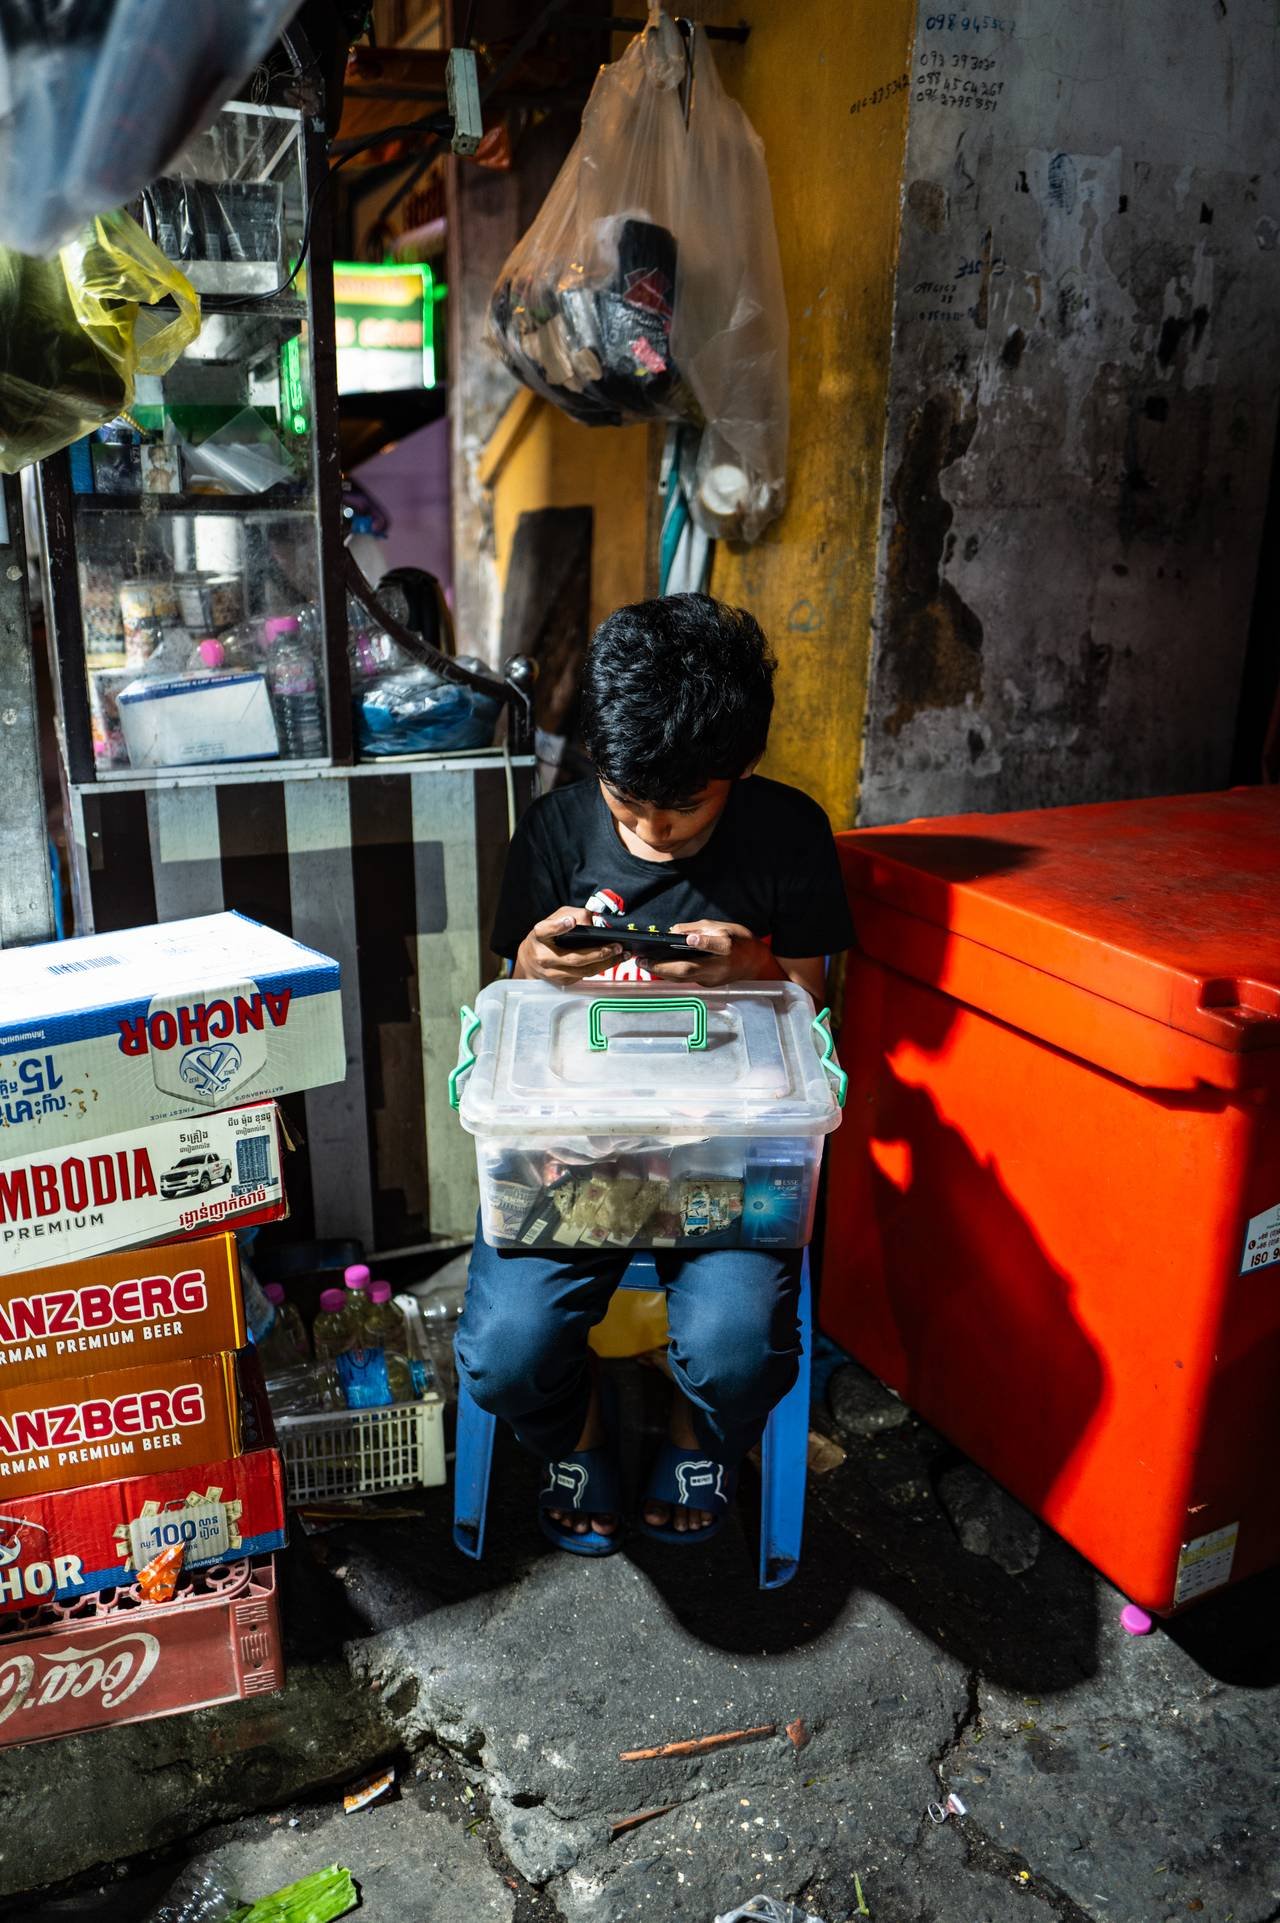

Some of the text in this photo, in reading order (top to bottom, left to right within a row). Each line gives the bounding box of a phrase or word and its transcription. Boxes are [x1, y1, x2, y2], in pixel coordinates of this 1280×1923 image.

[118, 987, 293, 1057] ANCHOR
[19, 1054, 64, 1095] 15
[4, 1213, 104, 1242] PREMIUM
[1250, 1251, 1268, 1267] ISO
[56, 1328, 135, 1355] PREMIUM
[142, 1321, 184, 1341] BEER
[58, 1441, 134, 1466] PREMIUM
[142, 1432, 182, 1451] BEER
[150, 1520, 197, 1548] 100
